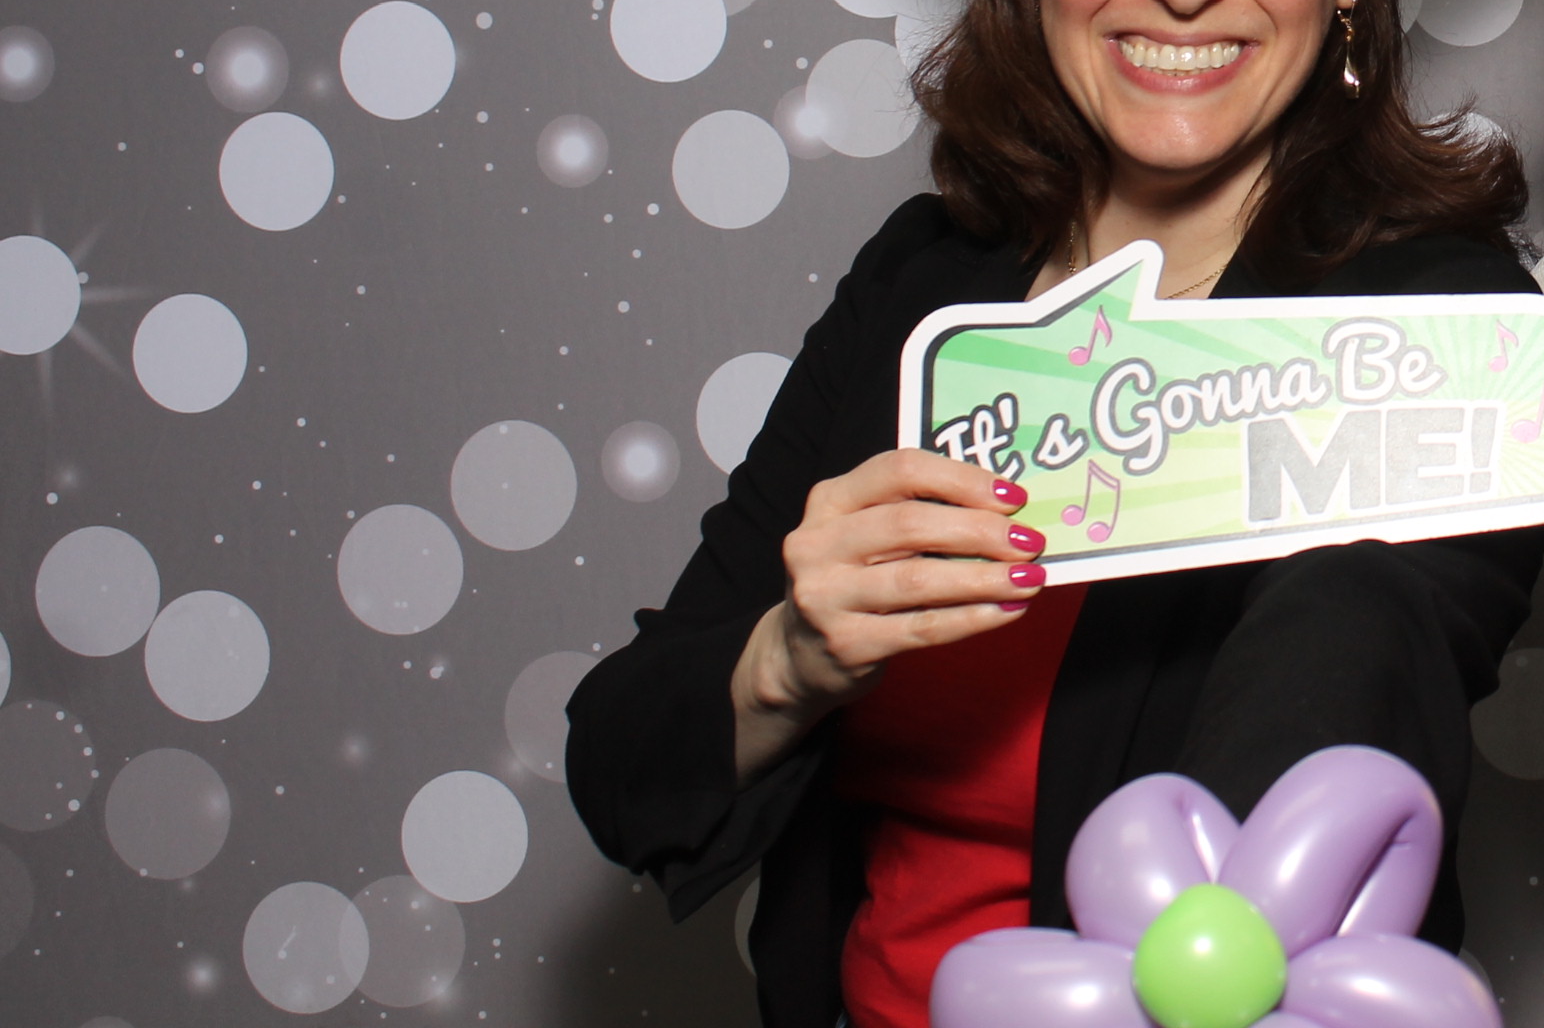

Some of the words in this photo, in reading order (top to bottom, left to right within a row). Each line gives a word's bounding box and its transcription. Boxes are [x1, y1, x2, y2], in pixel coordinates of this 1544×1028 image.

[933, 393, 1089, 482] It's
[1093, 358, 1331, 475] Gonna
[1323, 318, 1447, 404] Be
[1247, 407, 1499, 522] ME!
